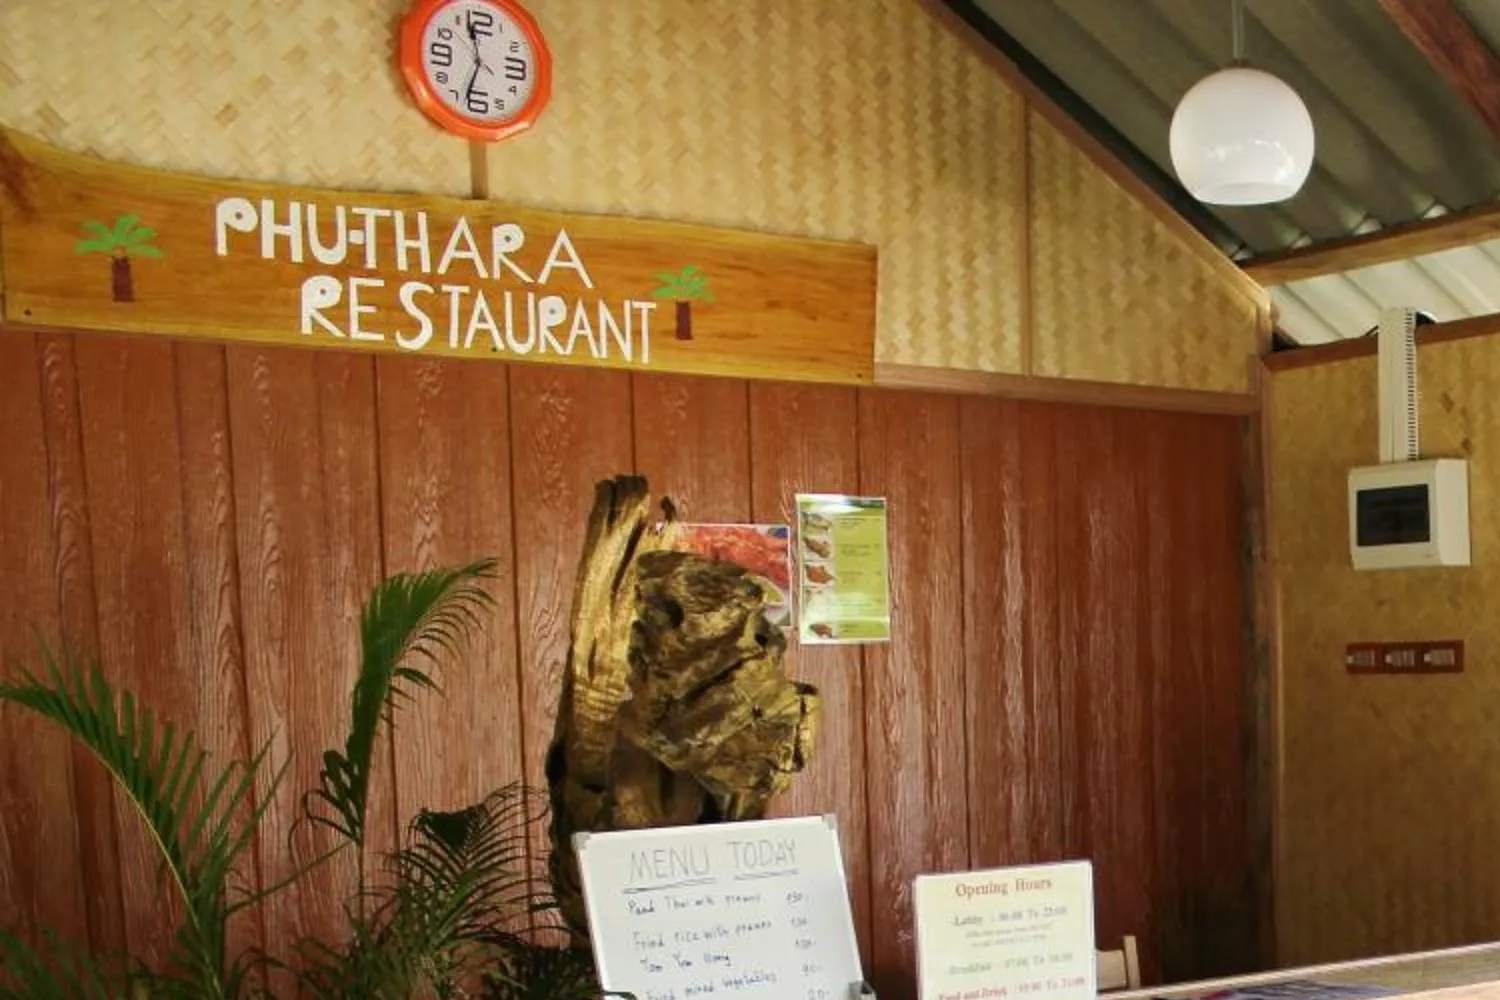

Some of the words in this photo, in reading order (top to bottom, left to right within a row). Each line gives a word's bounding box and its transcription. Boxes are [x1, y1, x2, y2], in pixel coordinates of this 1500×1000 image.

[431, 42, 453, 67] 9
[504, 56, 526, 81] 3
[467, 88, 489, 114] 6
[300, 274, 657, 364] RESTAURANT
[629, 845, 711, 883] MENU
[726, 838, 797, 869] TODAY
[955, 880, 1009, 901] Opening
[1015, 877, 1053, 893] Hours
